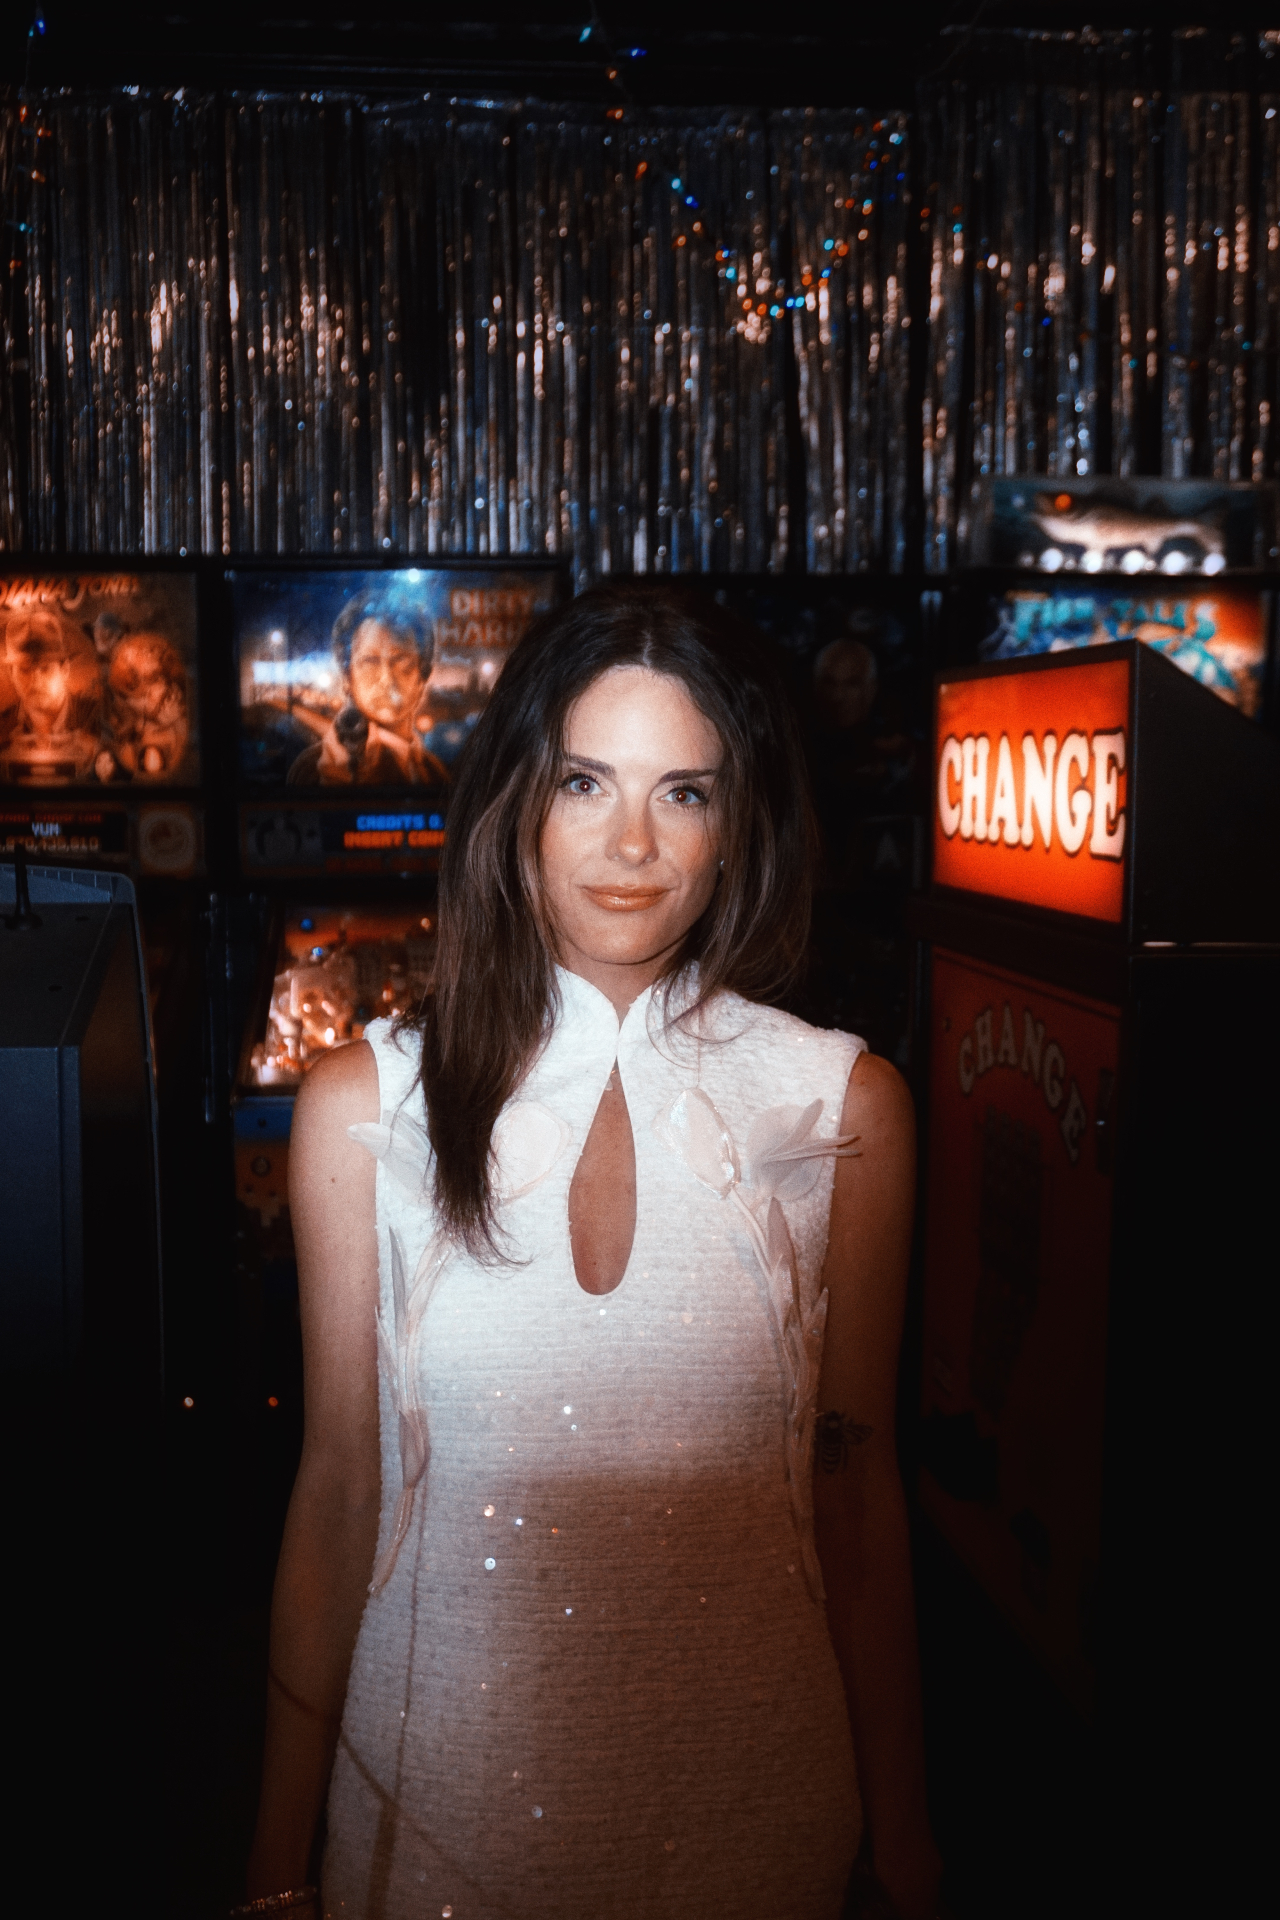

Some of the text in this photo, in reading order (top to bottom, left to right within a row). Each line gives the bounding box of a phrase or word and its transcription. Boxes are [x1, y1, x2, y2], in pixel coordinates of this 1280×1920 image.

[356, 813, 425, 832] CREDITS
[938, 728, 1127, 863] CHANGE
[958, 1003, 1087, 1164] CHANGE
